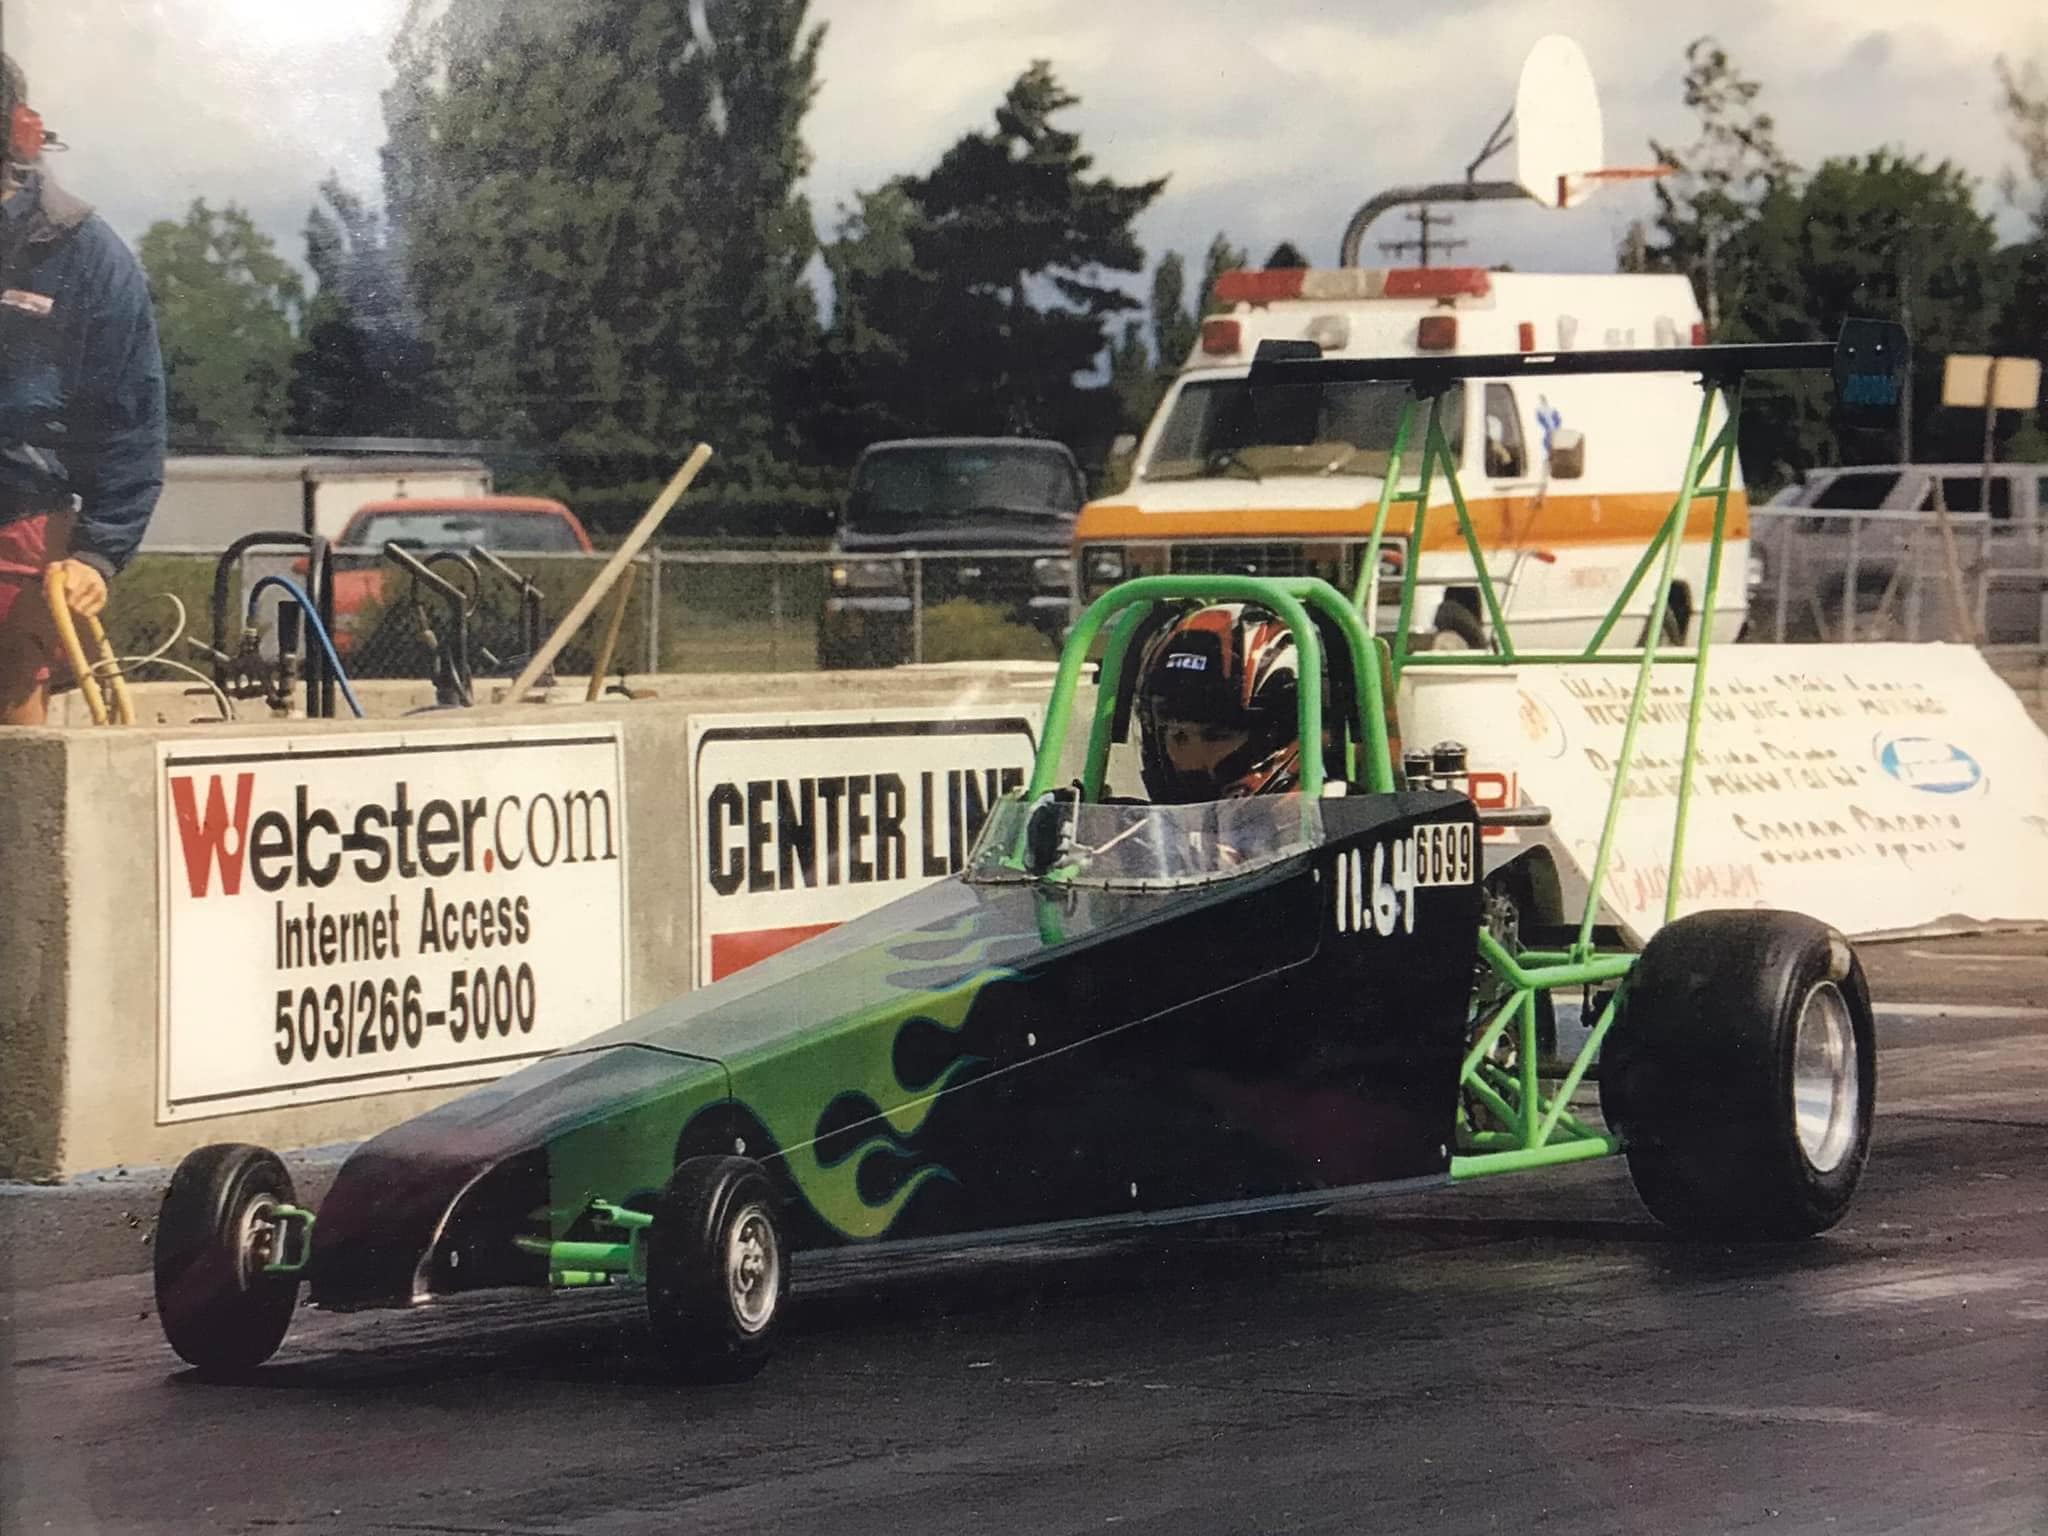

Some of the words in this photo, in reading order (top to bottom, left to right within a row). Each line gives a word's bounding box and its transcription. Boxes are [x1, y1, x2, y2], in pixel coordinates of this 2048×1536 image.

[708, 773, 906, 896] CENTER
[921, 768, 1024, 878] LIN
[1416, 825, 1471, 884] 6699
[276, 894, 400, 970] Internet
[419, 887, 530, 954] Access
[1336, 837, 1415, 936] 11.64
[274, 962, 537, 1066] 503/266-5000
